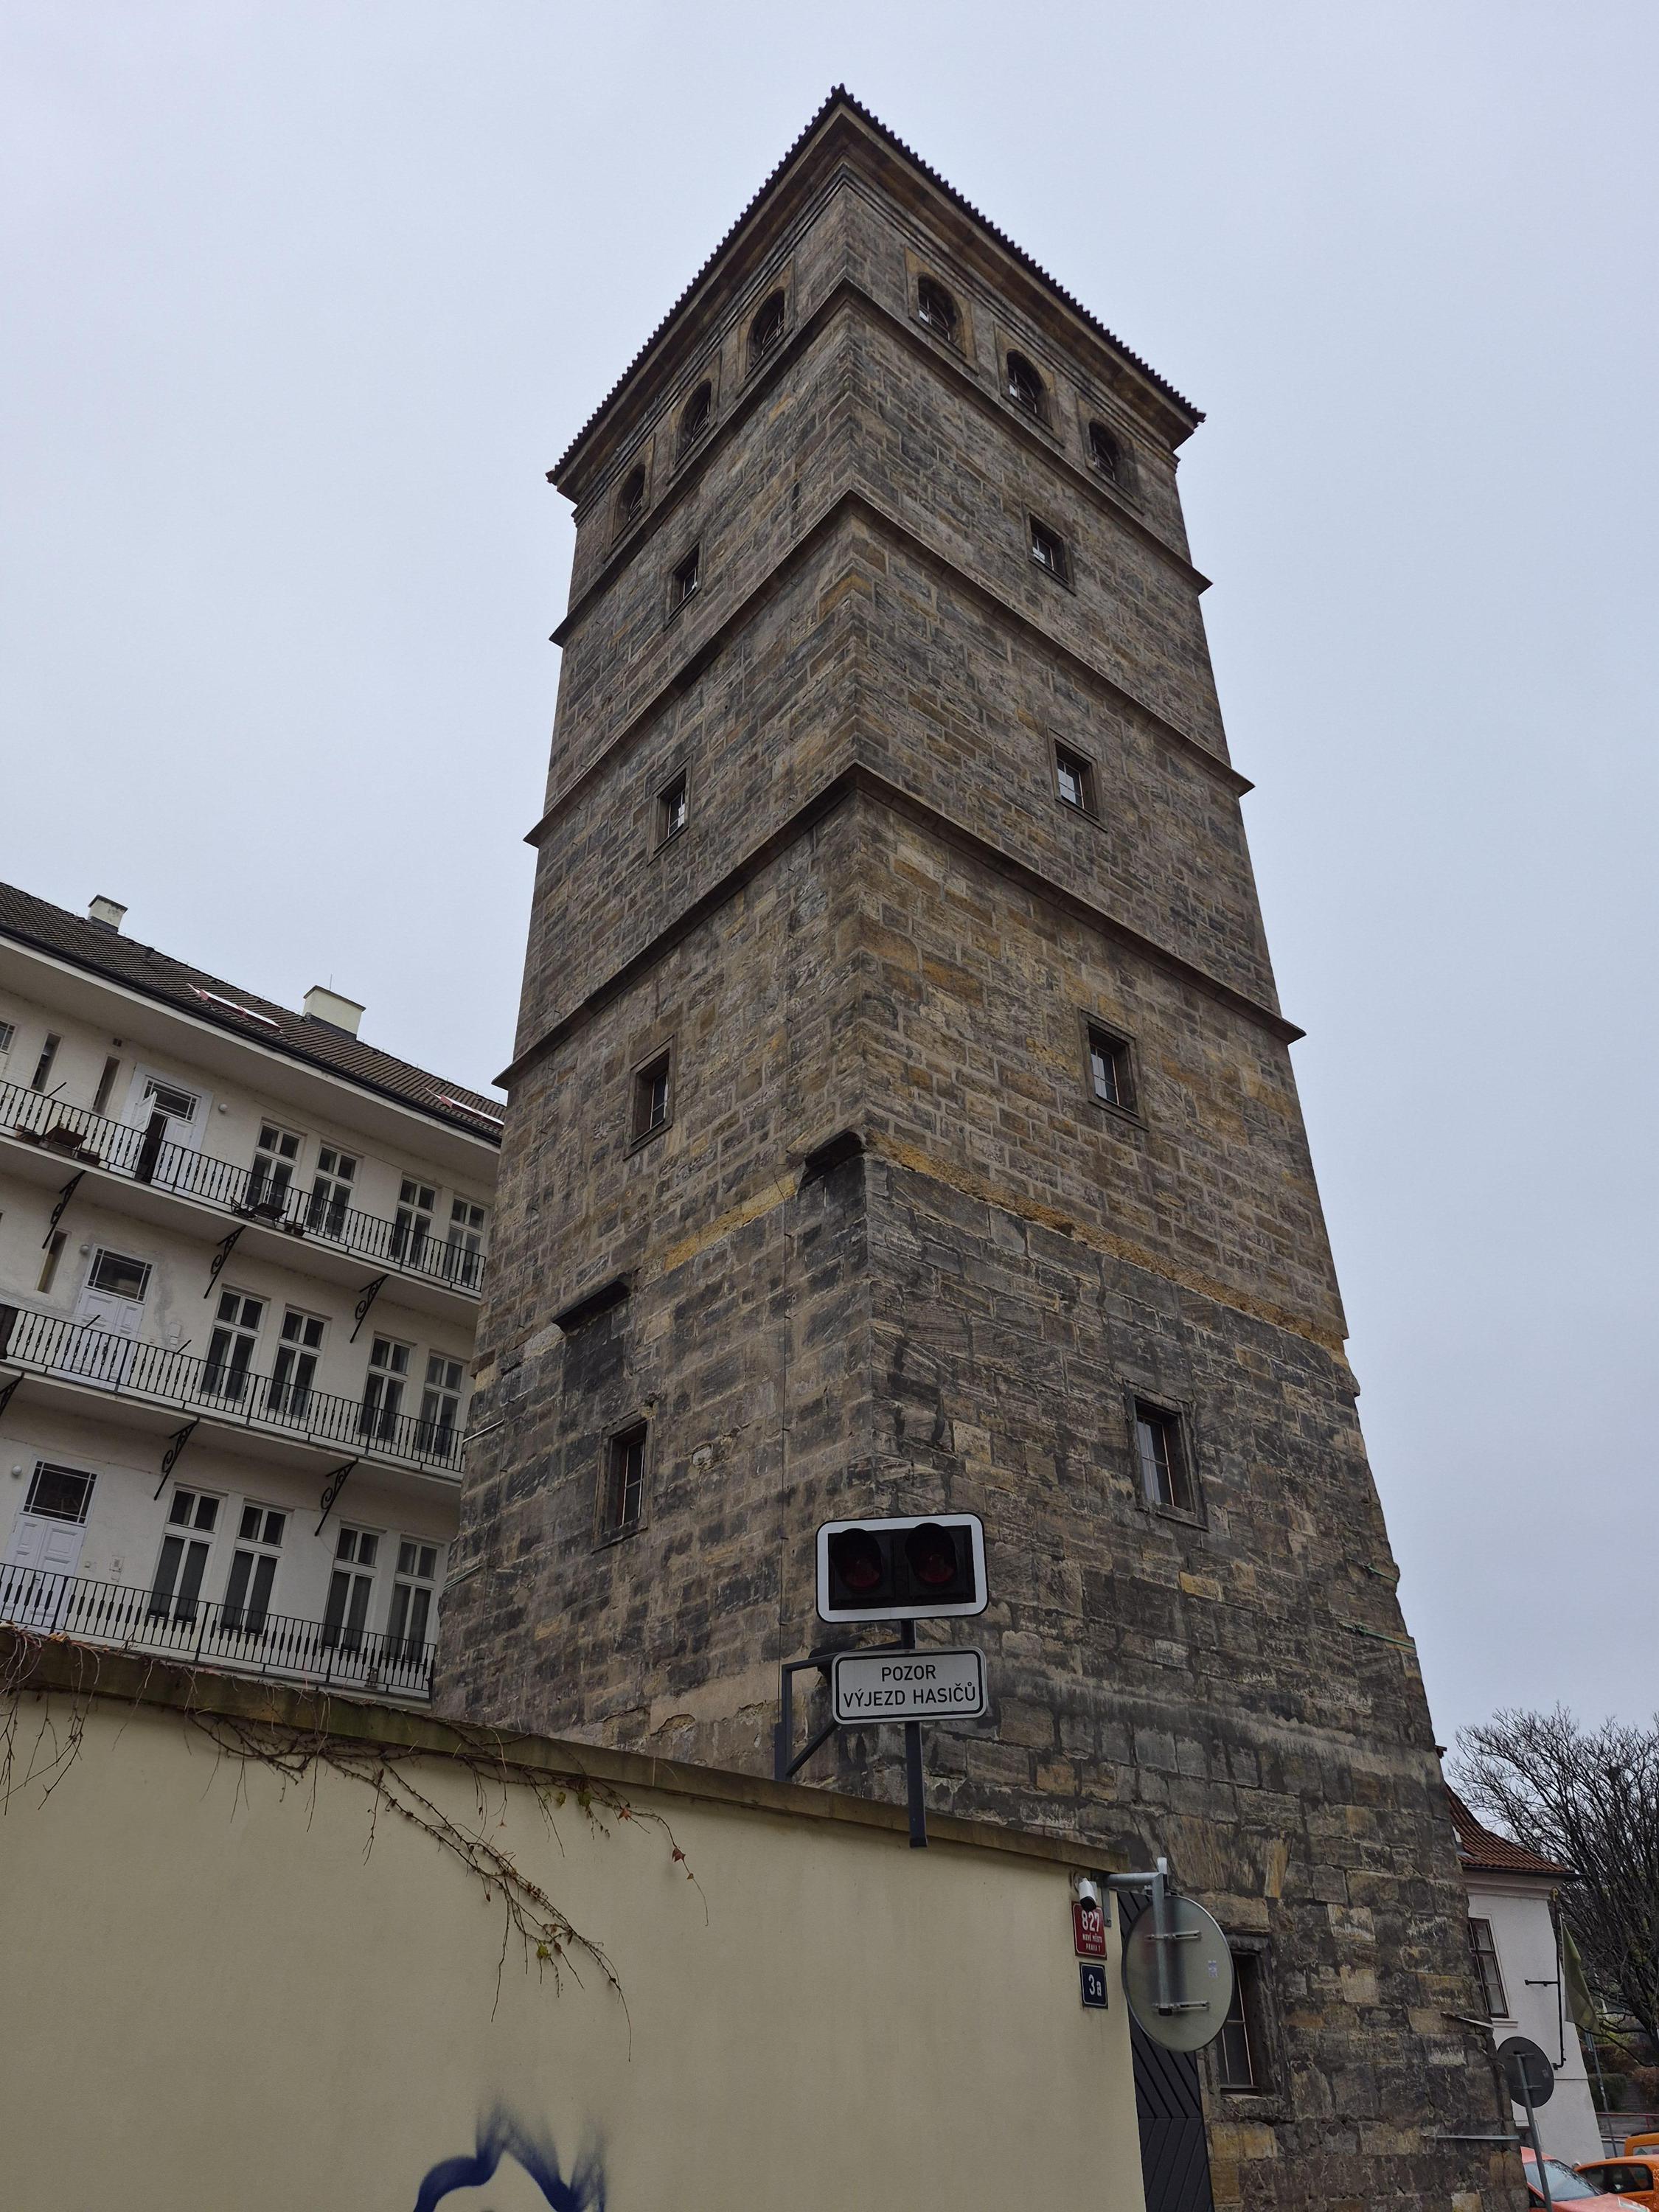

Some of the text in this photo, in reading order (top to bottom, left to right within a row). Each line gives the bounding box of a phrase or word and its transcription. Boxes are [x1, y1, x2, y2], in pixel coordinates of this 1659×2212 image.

[881, 1664, 936, 1682] POZOR
[843, 1681, 975, 1708] VÝJEZD HASIČŮ
[1082, 1910, 1099, 1933] 827
[1088, 1974, 1102, 1997] 3a
